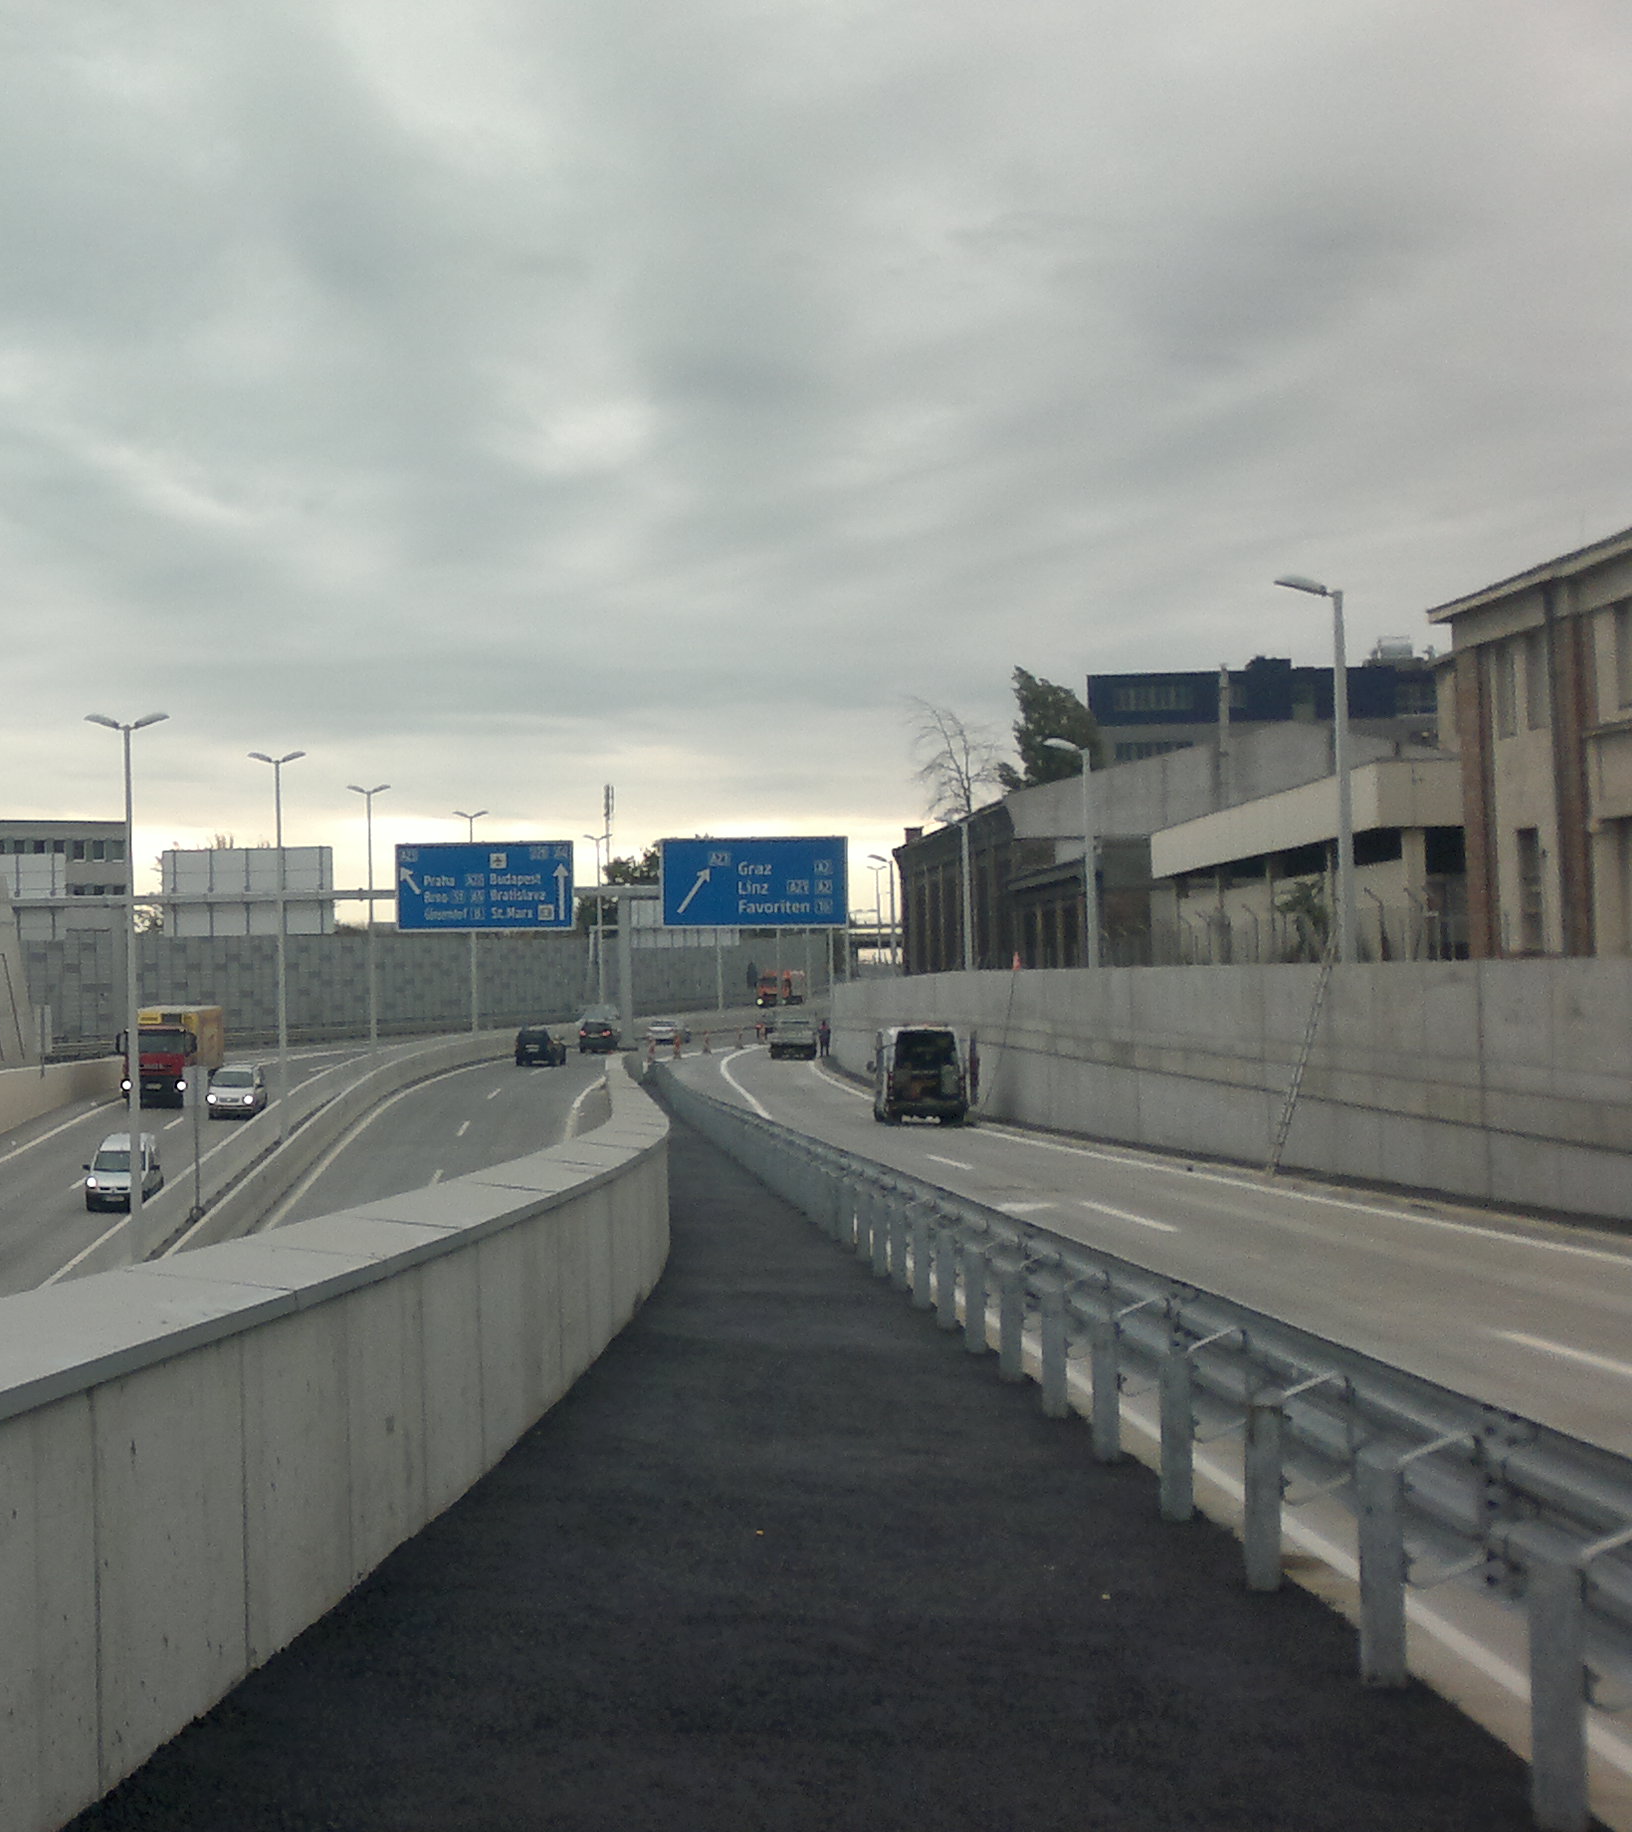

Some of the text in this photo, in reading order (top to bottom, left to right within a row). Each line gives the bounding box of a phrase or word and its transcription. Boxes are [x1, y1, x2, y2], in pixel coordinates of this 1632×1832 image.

[738, 861, 772, 876] Graz
[423, 874, 455, 887] Praha
[489, 872, 541, 886] Budapest
[490, 888, 546, 901] Bratislava
[738, 880, 768, 895] Linz
[738, 899, 810, 914] Favoriten
